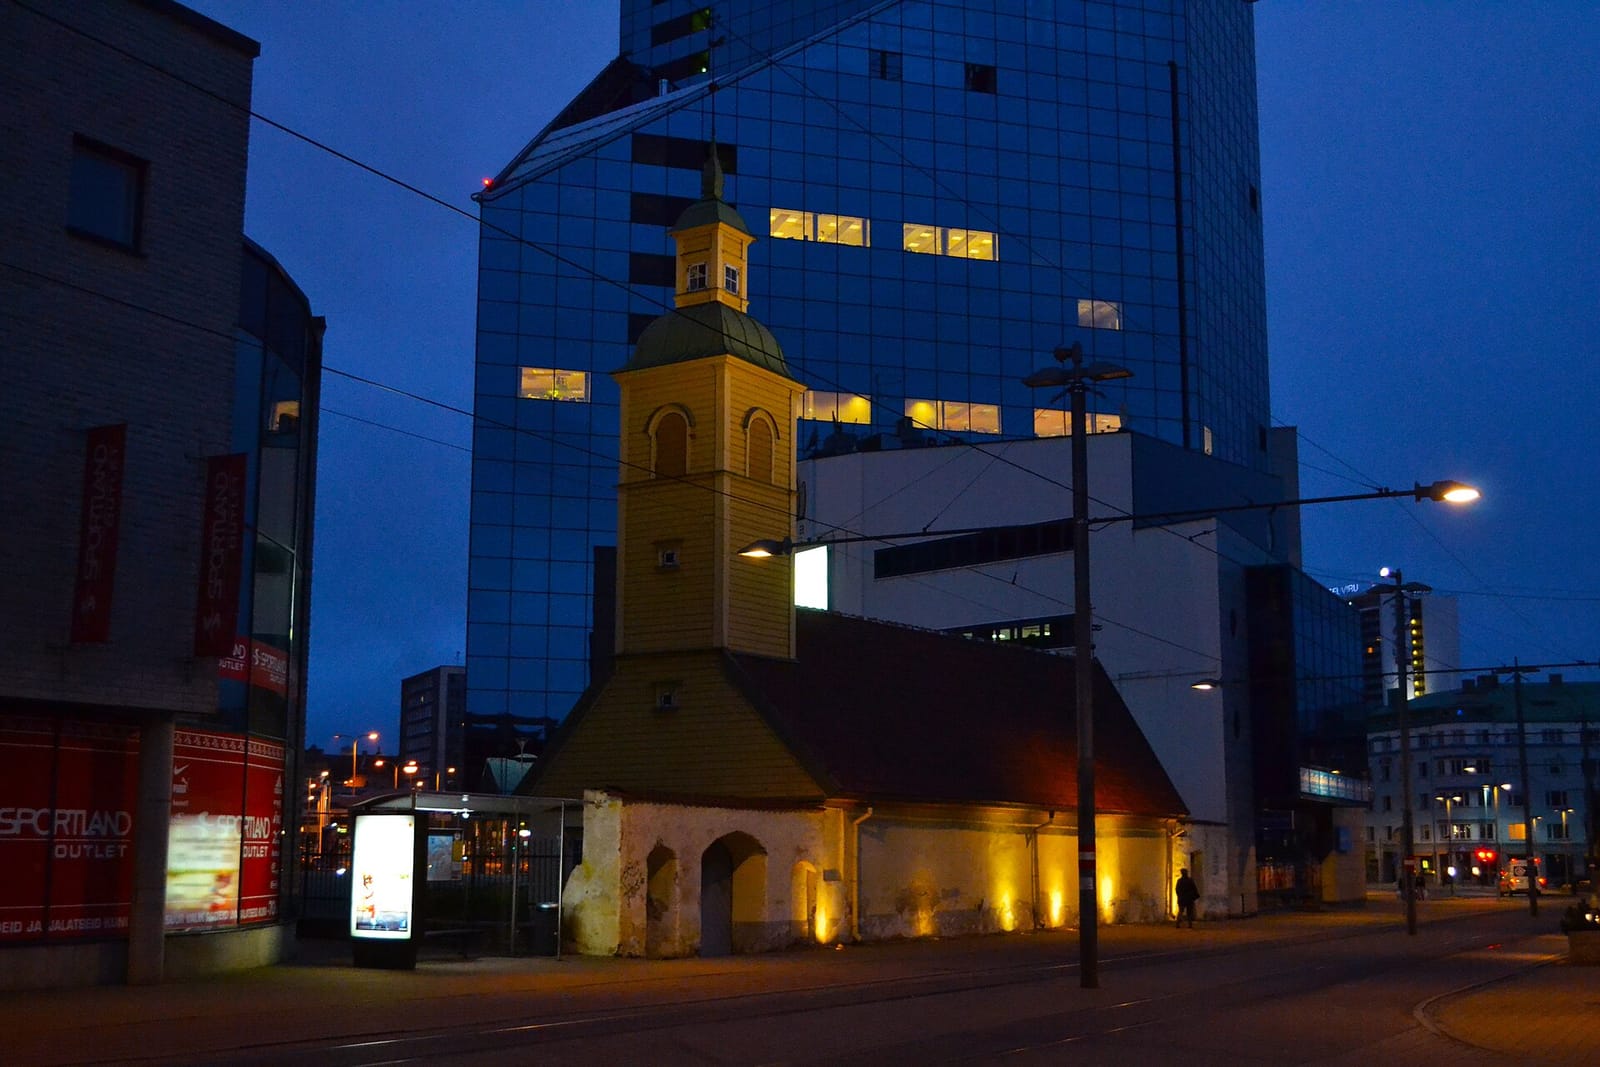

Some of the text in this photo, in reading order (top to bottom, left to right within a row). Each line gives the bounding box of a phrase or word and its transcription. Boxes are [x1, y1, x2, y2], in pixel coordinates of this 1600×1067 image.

[207, 471, 229, 600] SPORTLAND
[0, 807, 132, 836] SPORTLAND
[54, 844, 129, 859] OUTLET
[242, 845, 269, 858] OUTLET
[26, 919, 43, 932] JA
